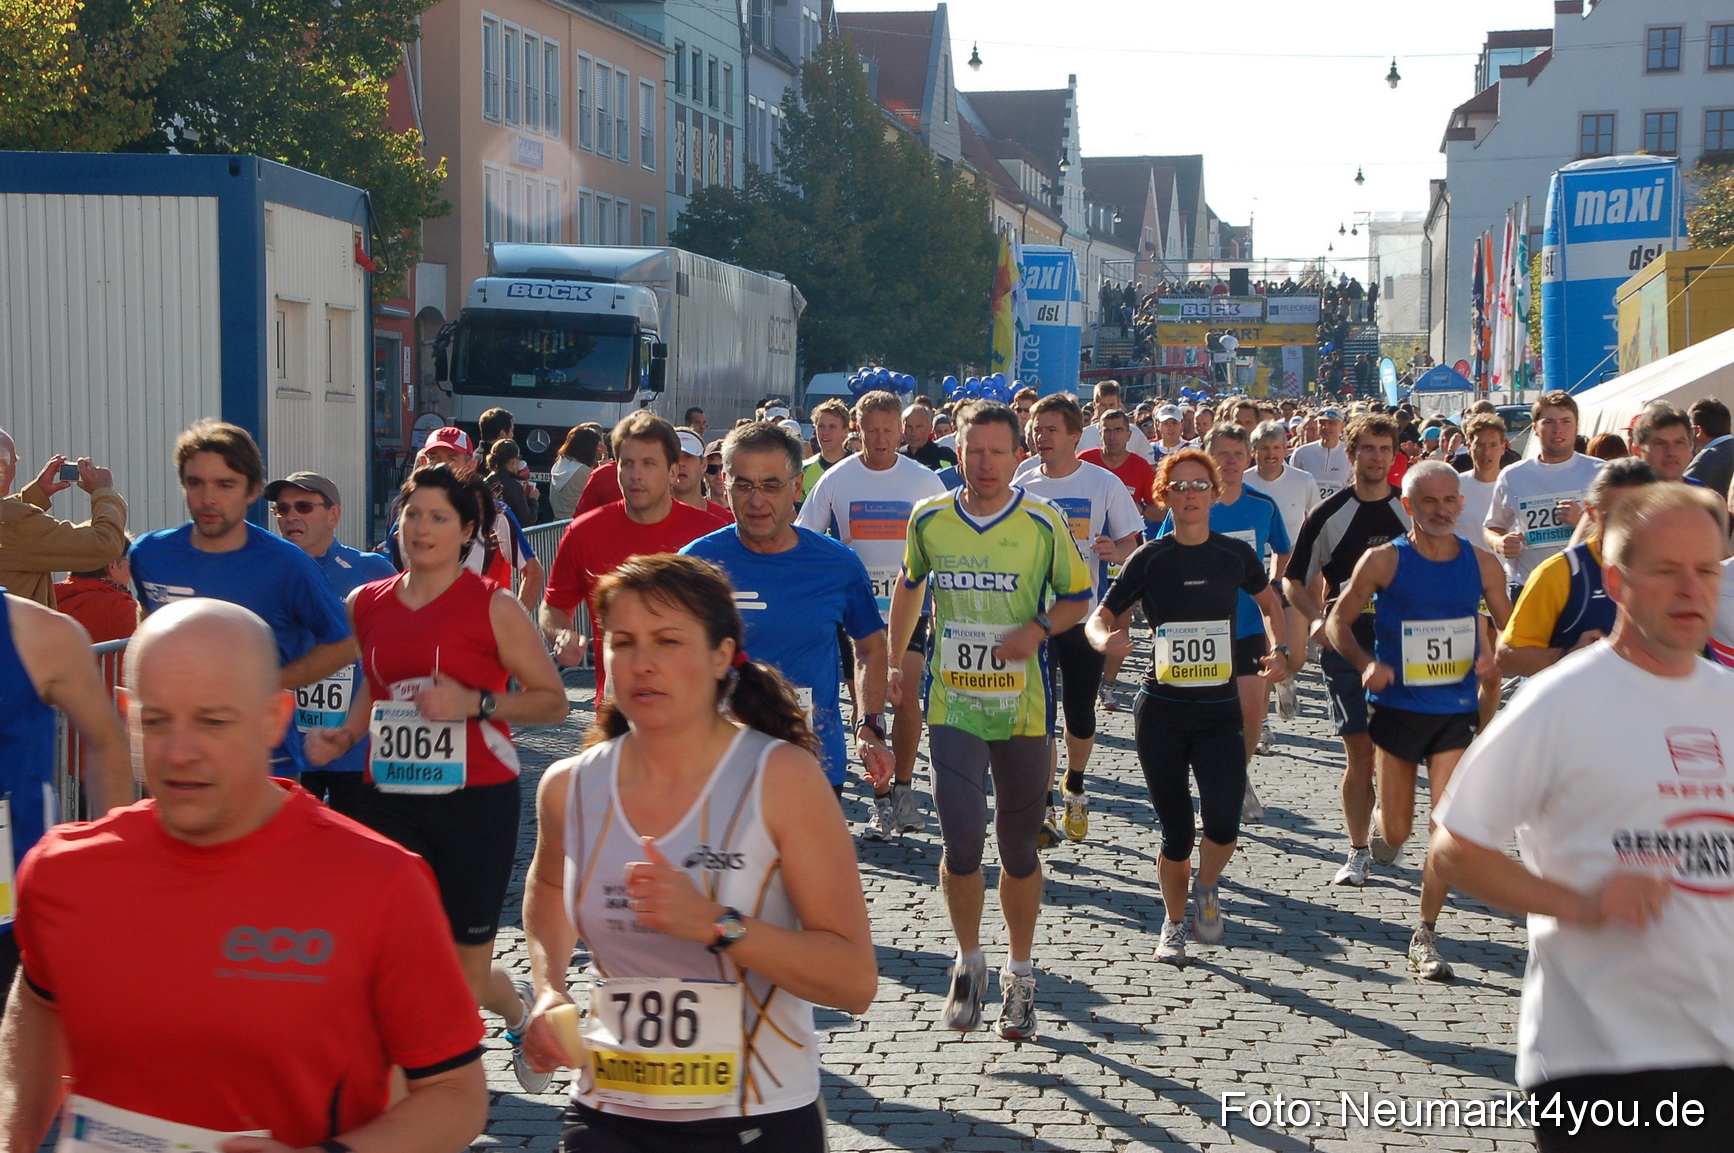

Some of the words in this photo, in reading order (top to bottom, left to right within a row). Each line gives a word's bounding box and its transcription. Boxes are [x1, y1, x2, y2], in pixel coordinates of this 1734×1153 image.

[1574, 178, 1665, 226] maxi
[1024, 261, 1064, 290] axi
[507, 283, 593, 301] BOCK
[1037, 304, 1060, 322] dsl
[1181, 303, 1241, 316] BOCK
[1280, 304, 1317, 313] PFLEIDERER
[935, 555, 989, 568] TEAM
[937, 571, 1019, 592] BOCK
[952, 629, 986, 638] PFLEIDERER
[1172, 638, 1216, 664] 509
[1427, 636, 1452, 661] 51
[1171, 664, 1218, 679] Gerlind
[1427, 661, 1456, 676] Willi
[951, 672, 1015, 688] Friedrich
[300, 711, 323, 726] Karl
[380, 724, 454, 760] 3064
[386, 762, 443, 781] Andrea
[224, 925, 336, 966] eco
[611, 989, 699, 1048] 786
[594, 1052, 732, 1086] Annemarie
